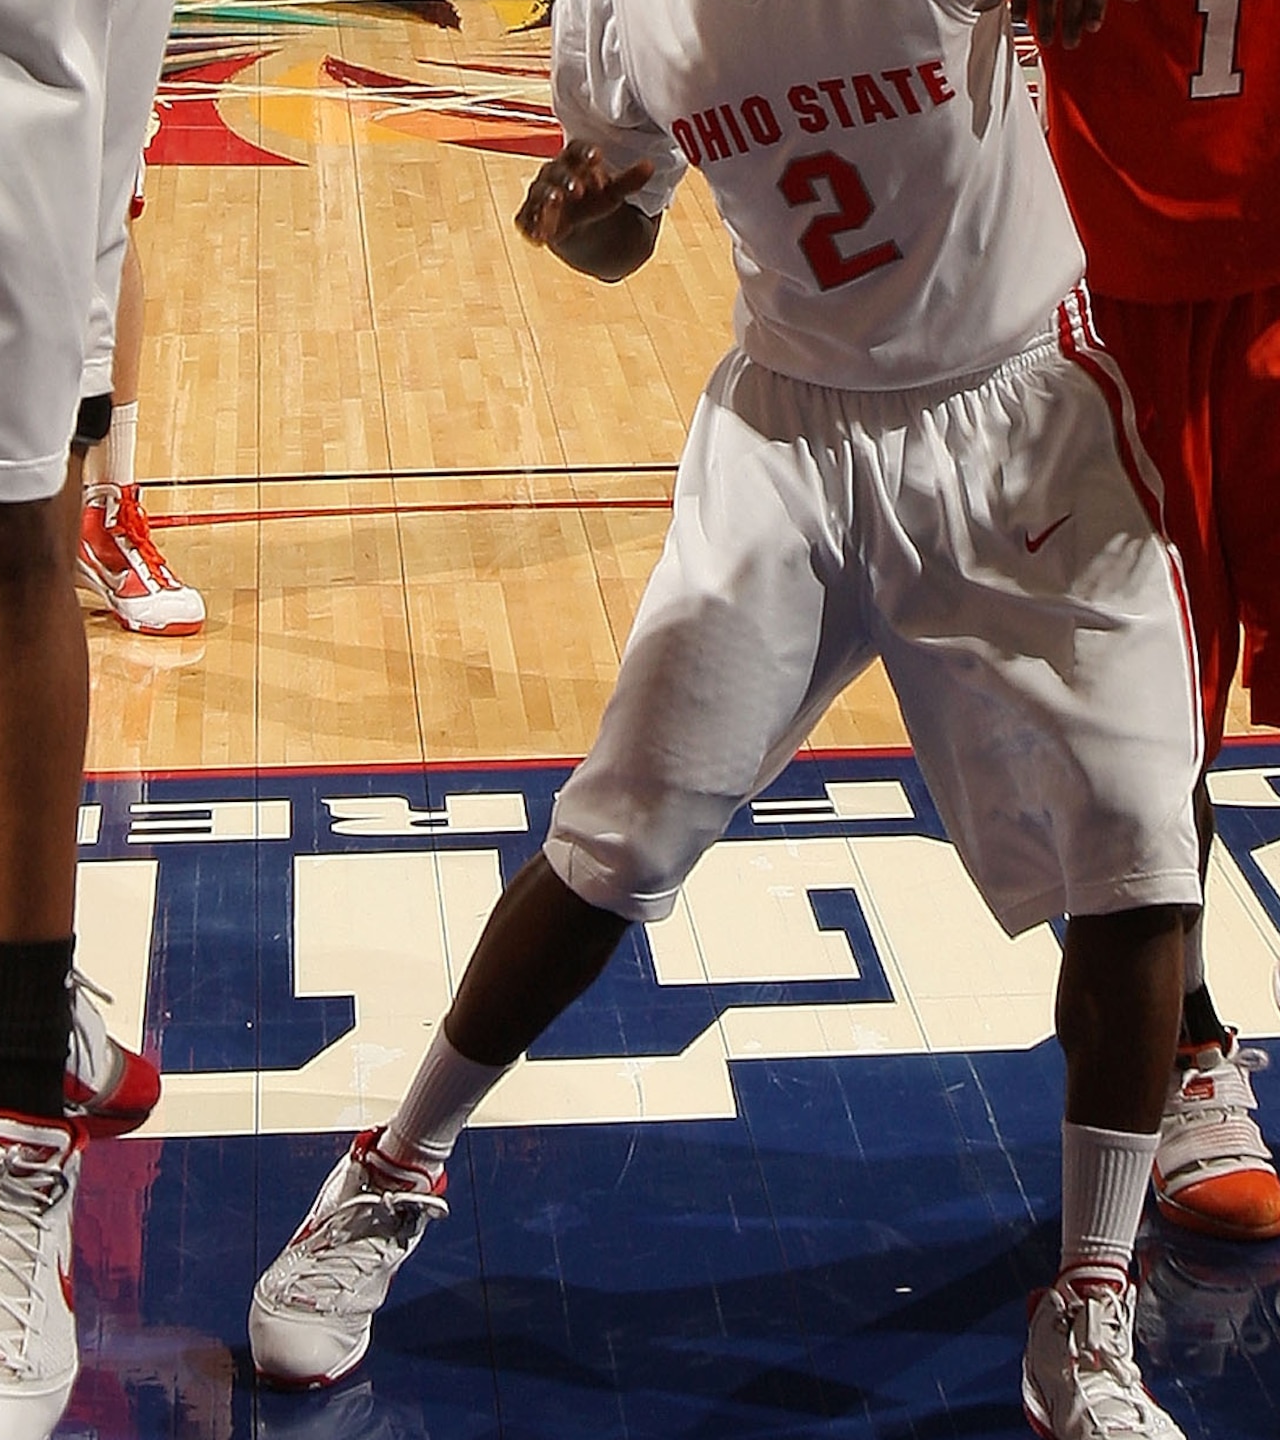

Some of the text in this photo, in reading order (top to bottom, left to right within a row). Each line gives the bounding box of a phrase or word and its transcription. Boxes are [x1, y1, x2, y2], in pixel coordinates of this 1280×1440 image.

[671, 59, 955, 168] OHIO STATE
[776, 150, 904, 292] 2
